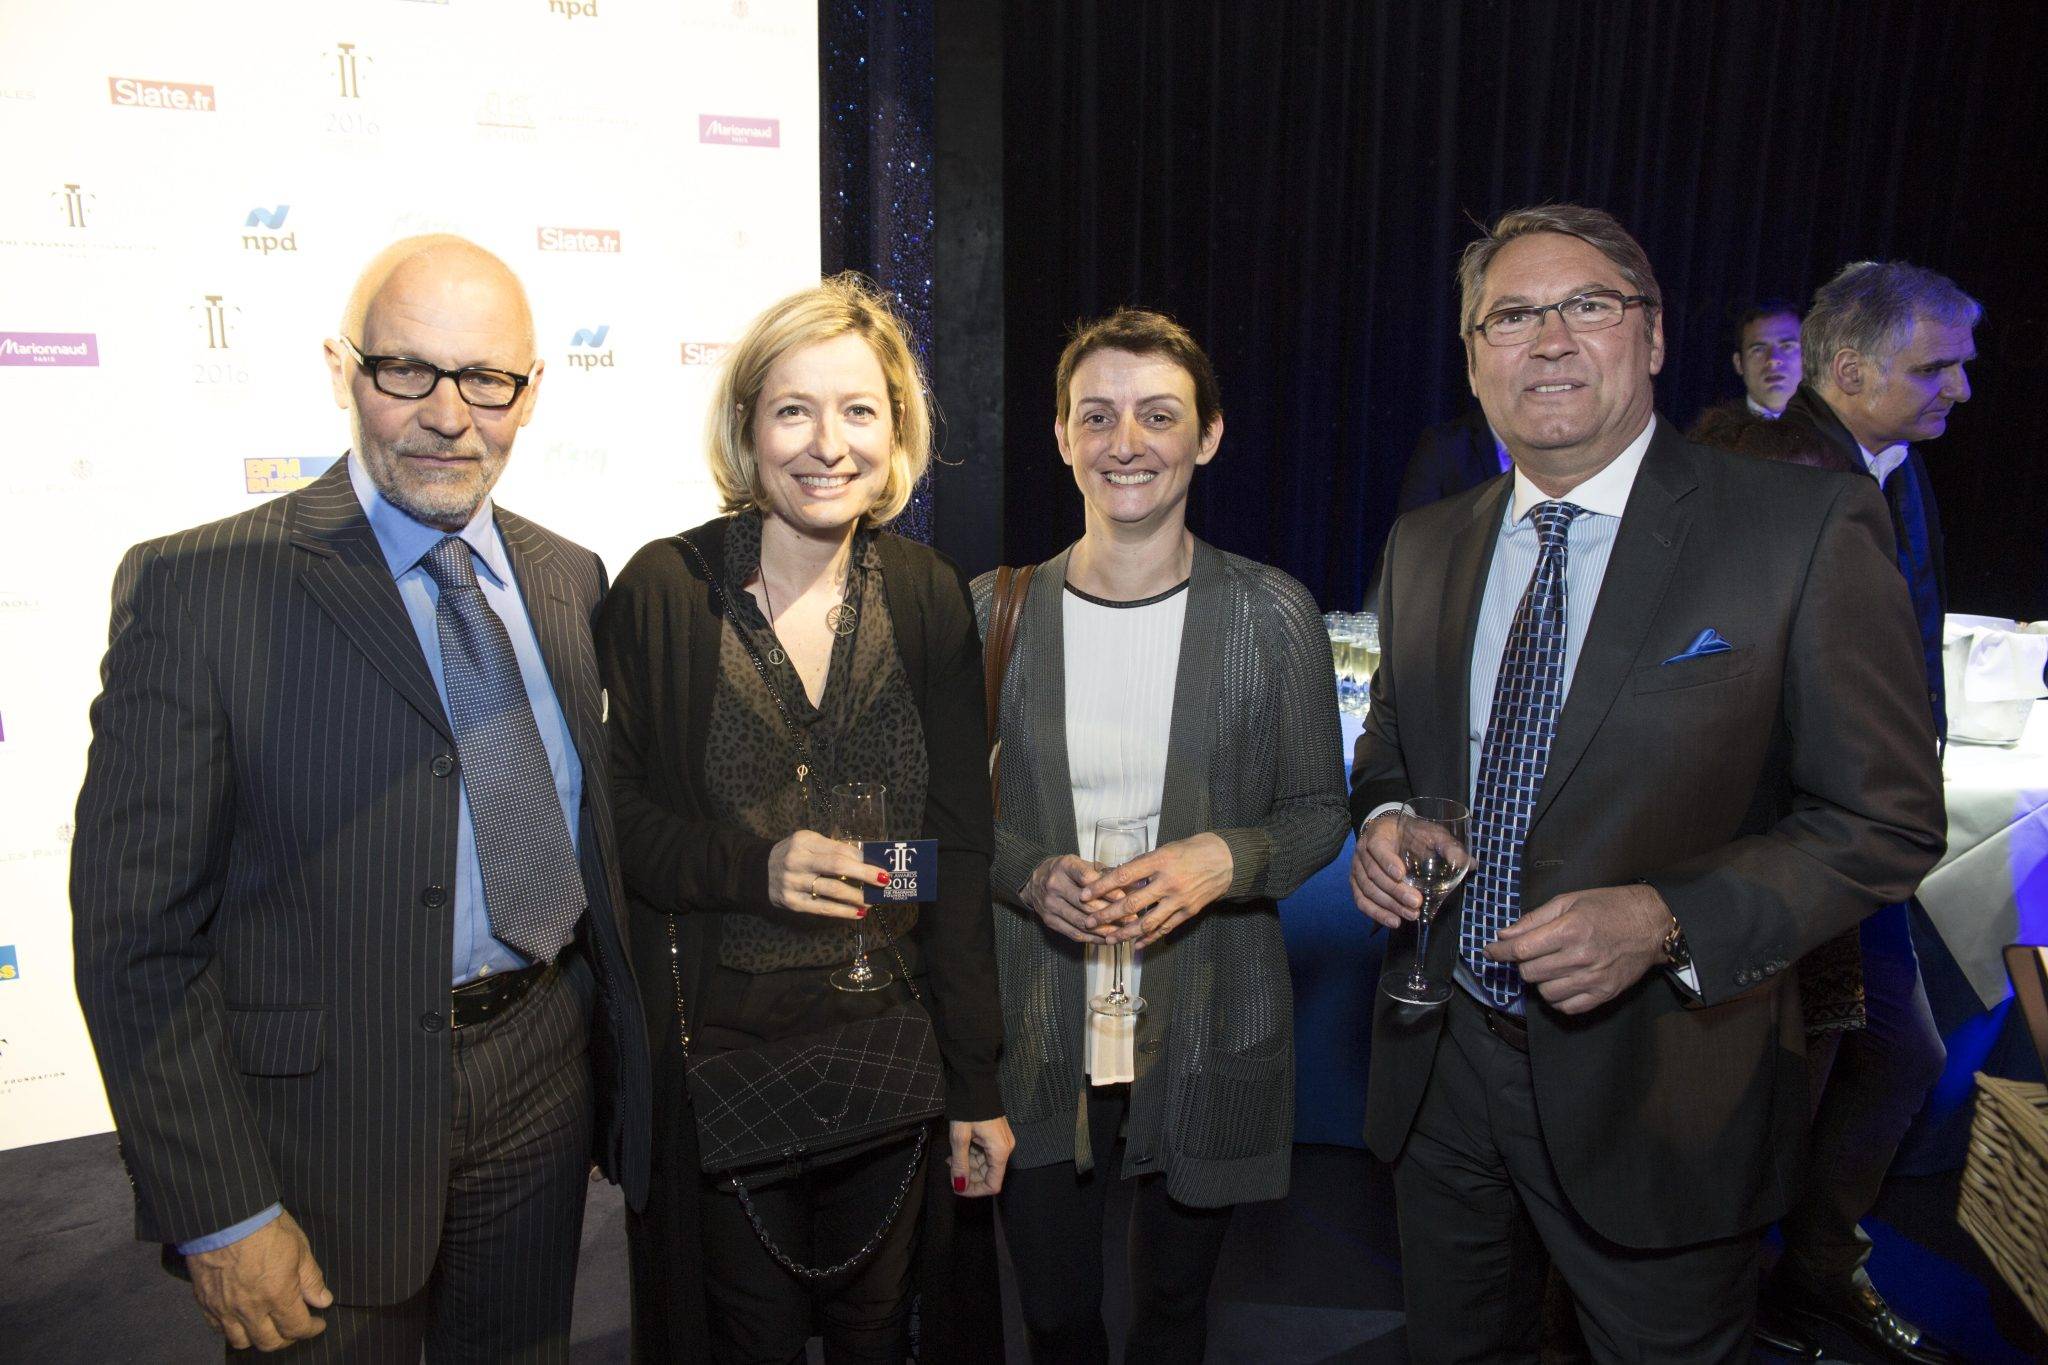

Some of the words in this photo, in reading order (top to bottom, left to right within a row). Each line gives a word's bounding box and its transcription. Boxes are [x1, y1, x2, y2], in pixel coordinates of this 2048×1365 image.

[549, 0, 598, 20] npd
[114, 79, 212, 112] Slate.fr
[705, 120, 772, 139] Marionnaud
[242, 231, 298, 256] npd
[540, 228, 619, 253] Slate.fr
[1, 338, 88, 356] Marionnaud
[568, 350, 615, 371] npd
[885, 878, 917, 889] 2016
